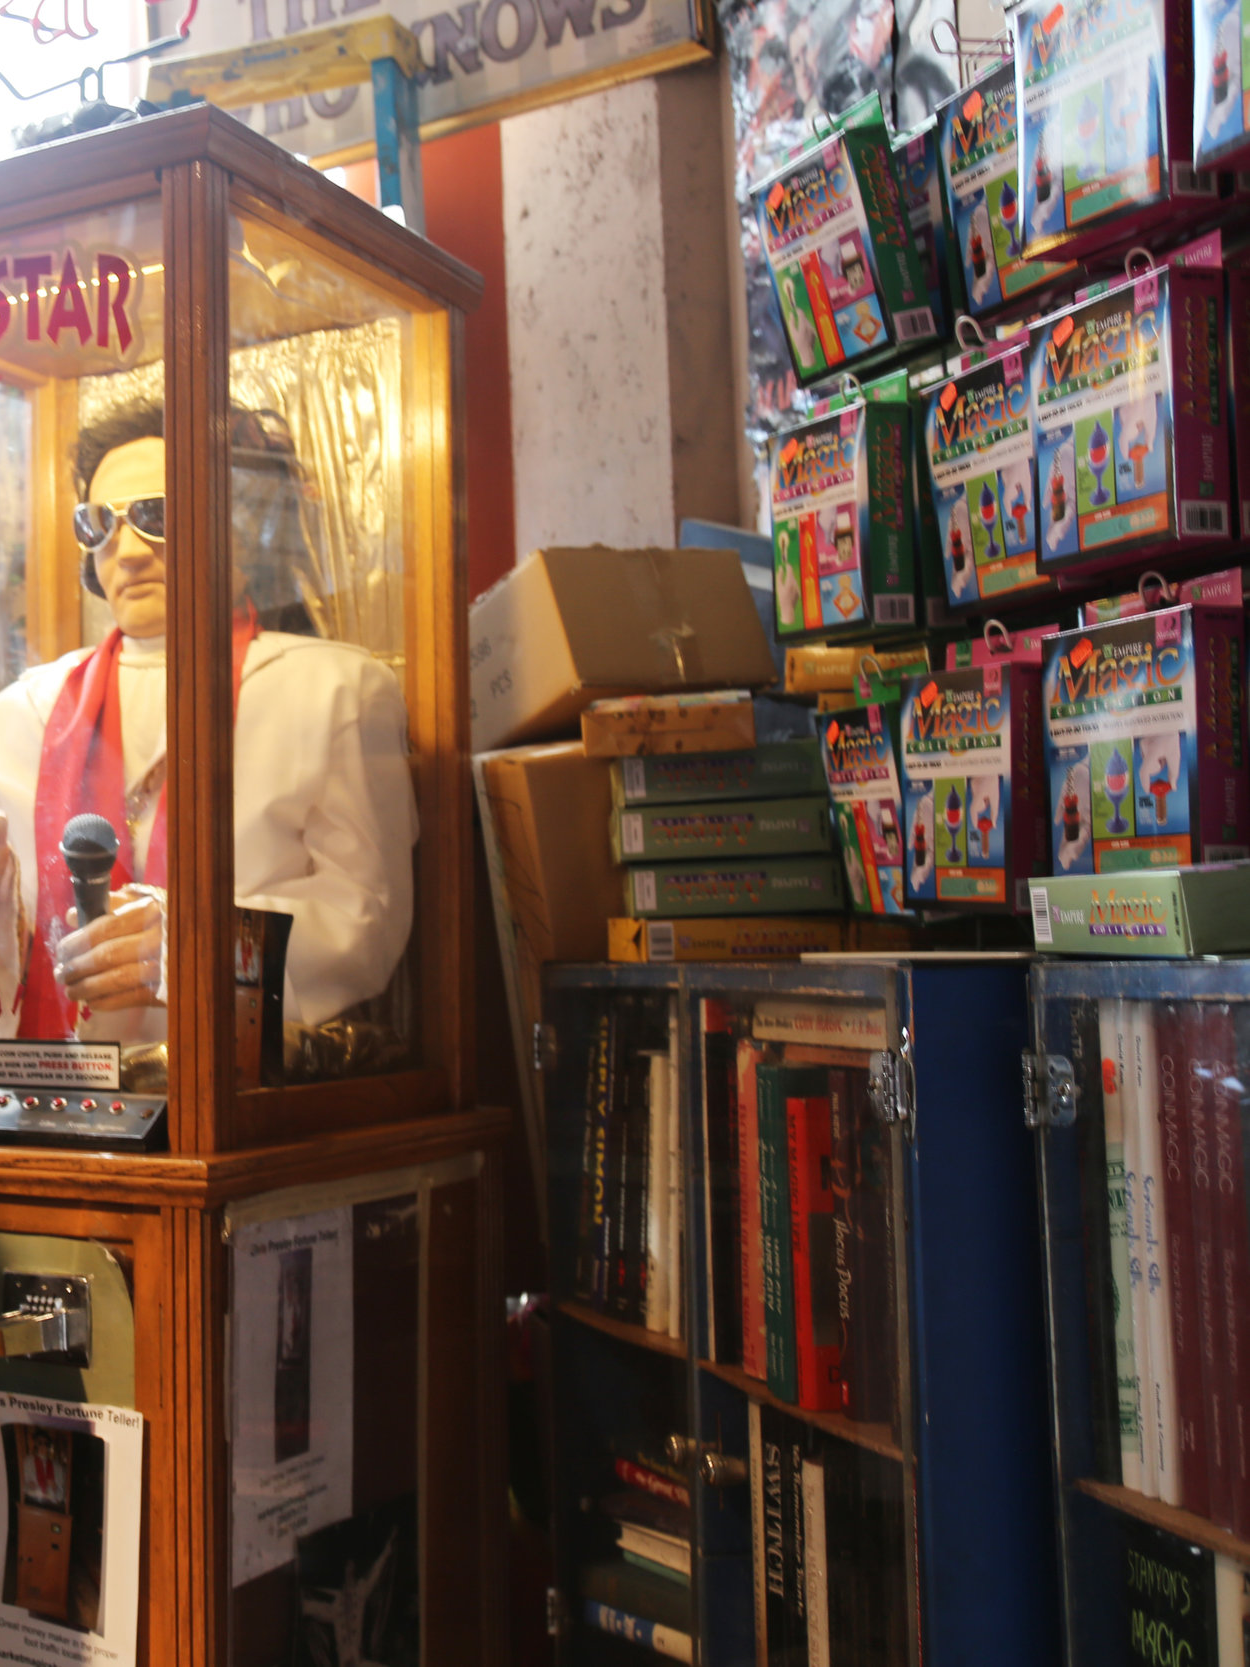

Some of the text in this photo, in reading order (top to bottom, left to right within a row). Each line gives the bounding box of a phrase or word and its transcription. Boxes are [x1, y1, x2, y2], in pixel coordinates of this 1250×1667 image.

[1040, 310, 1162, 389] Magic
[933, 382, 1030, 451] Magic
[1202, 582, 1232, 600] EMPIRE
[1051, 642, 1188, 704] Magic
[1113, 642, 1143, 659] EMPIRE
[907, 691, 1006, 740] Magic
[1050, 686, 1180, 719] COLLECTION
[1090, 888, 1168, 924] Magic
[38, 1061, 69, 1070] PRESS
[597, 1014, 610, 1118] SIMPLY
[1161, 1054, 1181, 1182] COINMAGIC
[593, 1126, 606, 1226] SIMON
[832, 1215, 853, 1320] Hocus Pocus
[1142, 1174, 1161, 1298] Seriously Silly
[9, 1396, 53, 1415] Presley
[56, 1403, 104, 1420] Fortune
[107, 1409, 141, 1429] Teller!
[764, 1442, 785, 1599] SWITCH
[1126, 1548, 1192, 1616] STANYON'S
[1131, 1607, 1193, 1667] MAGIC
